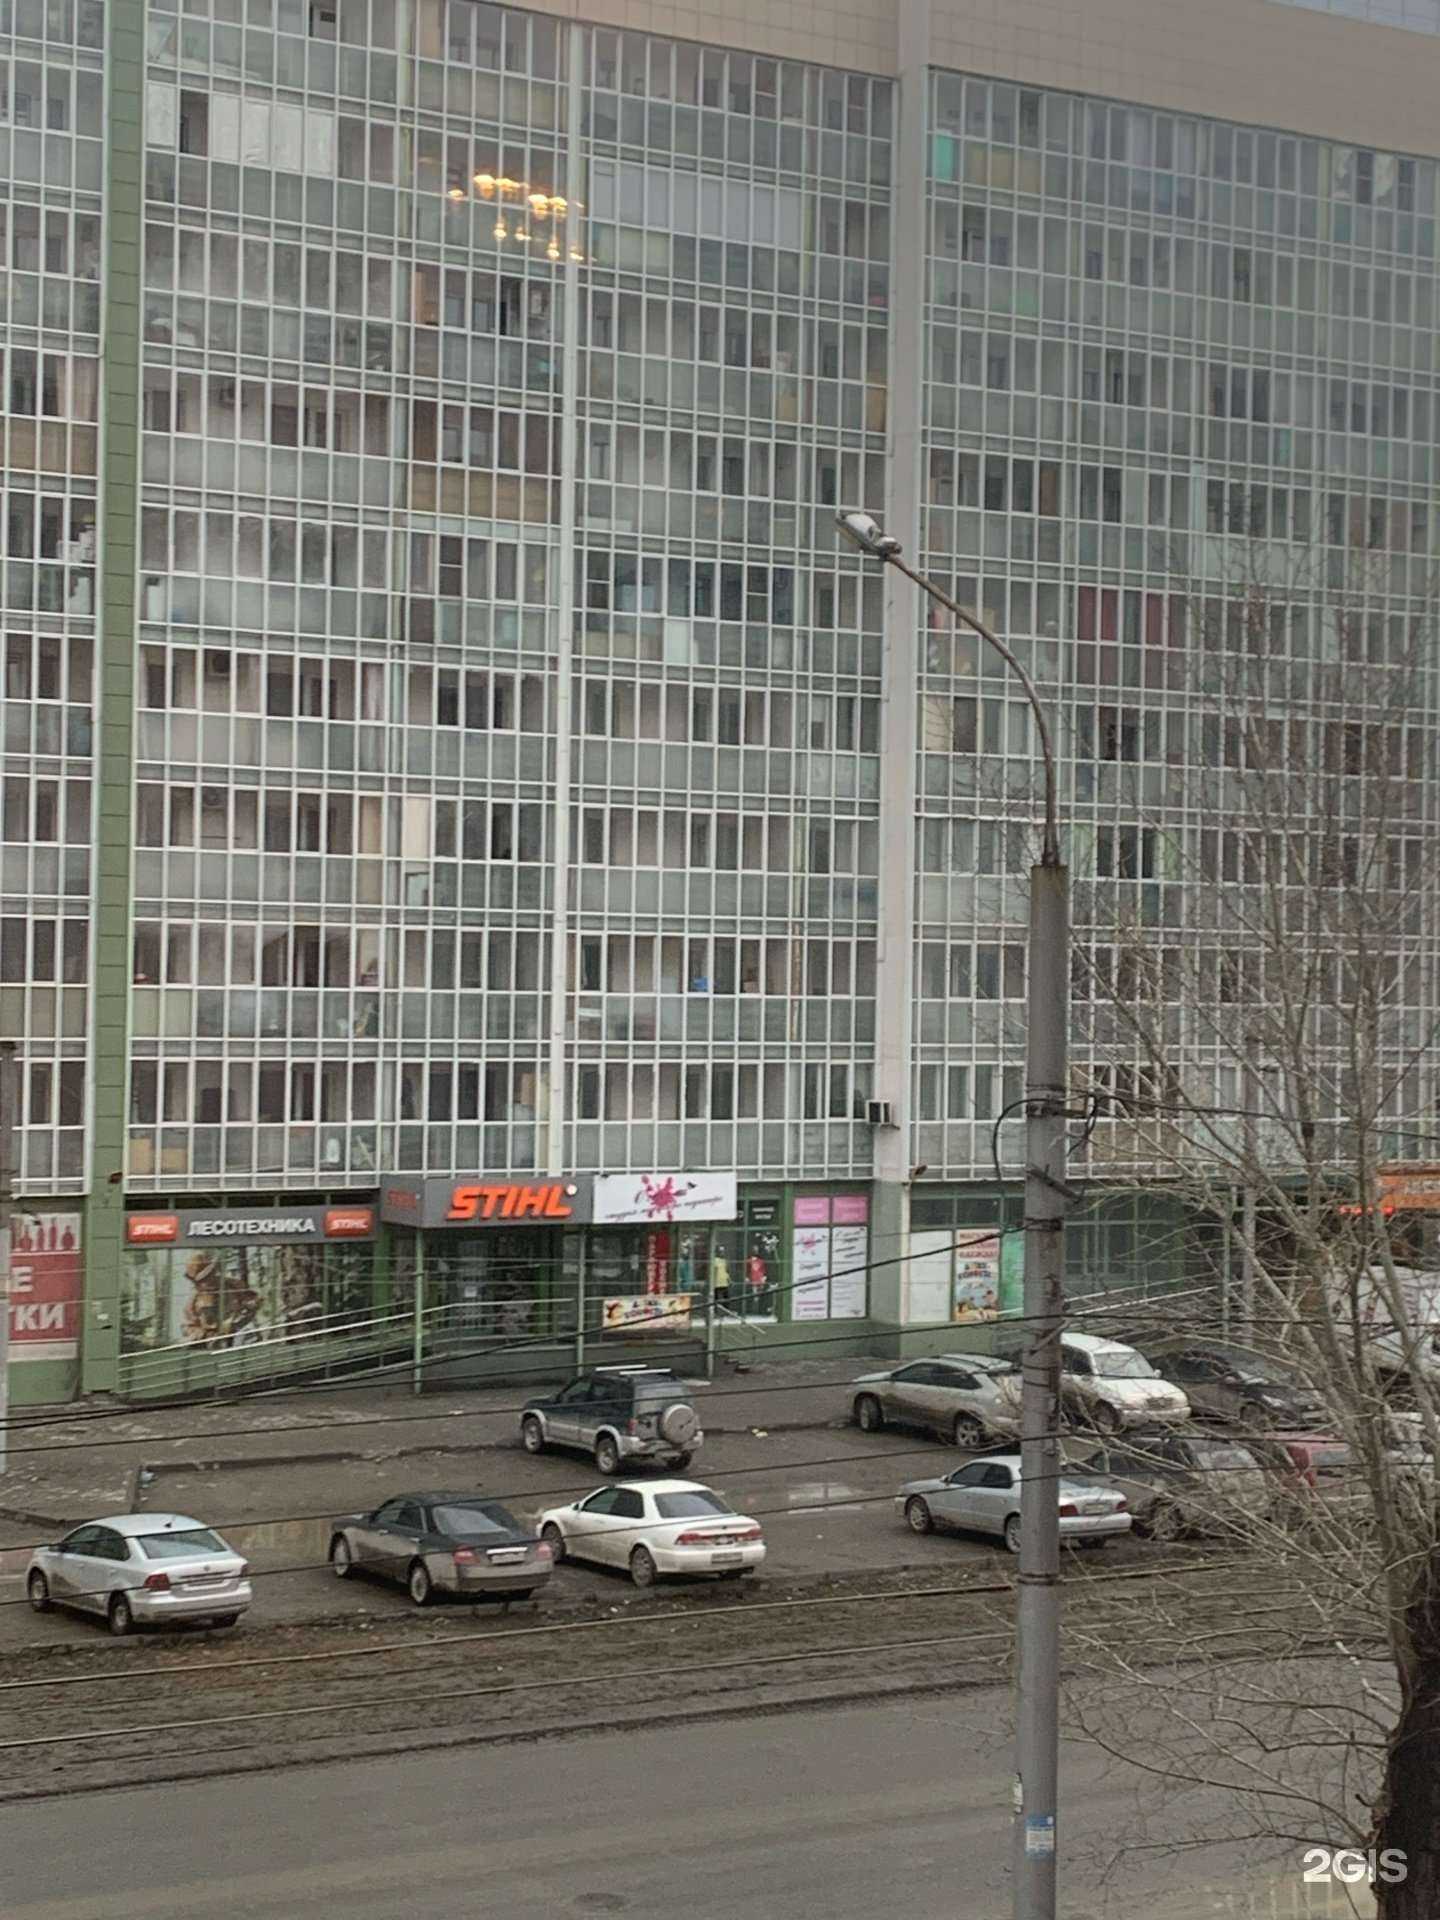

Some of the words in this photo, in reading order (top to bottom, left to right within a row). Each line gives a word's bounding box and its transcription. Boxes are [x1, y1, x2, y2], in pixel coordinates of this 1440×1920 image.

[447, 1185, 573, 1219] STIHL
[187, 1217, 316, 1236] ЛЕСОТЕХНИКА
[8, 1303, 65, 1331] КИ
